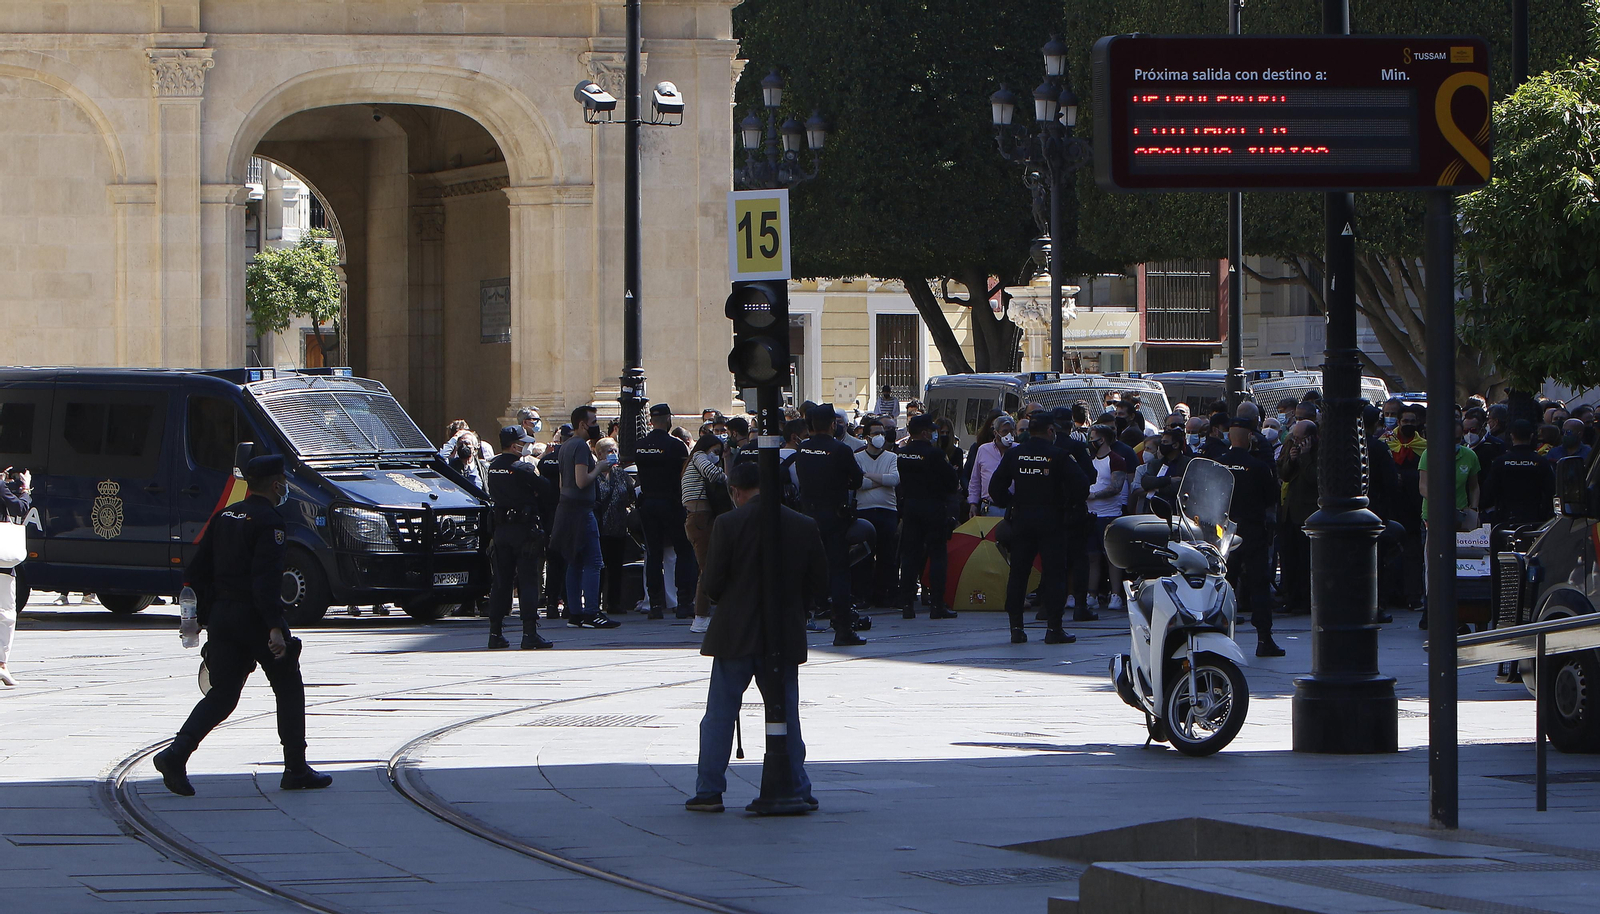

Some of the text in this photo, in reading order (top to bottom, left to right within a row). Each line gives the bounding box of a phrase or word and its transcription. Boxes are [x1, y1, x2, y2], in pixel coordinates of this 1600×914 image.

[1414, 52, 1447, 60] TUSSAM
[1134, 67, 1327, 81] Próxima salida con destino a:
[1381, 68, 1410, 81] Min.
[738, 211, 779, 259] 15
[1019, 467, 1043, 475] U.I.P.
